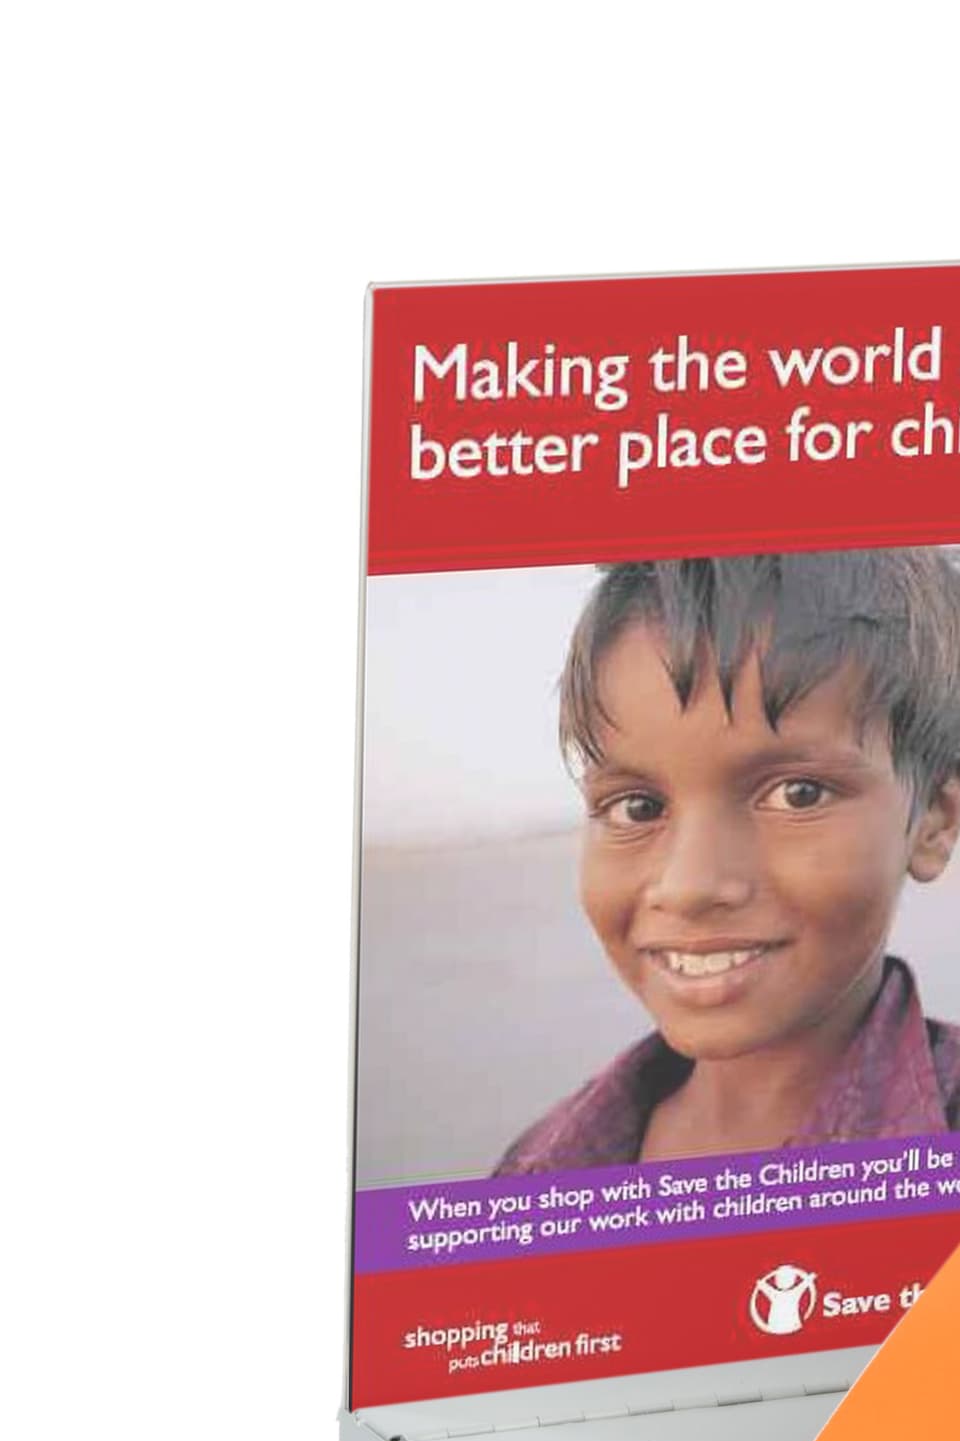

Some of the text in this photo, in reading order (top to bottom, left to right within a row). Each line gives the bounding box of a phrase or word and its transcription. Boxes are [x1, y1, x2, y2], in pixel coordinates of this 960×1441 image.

[413, 342, 629, 411] Making
[649, 335, 746, 392] the
[767, 325, 942, 387] world
[410, 424, 599, 480] better
[618, 414, 767, 487] place
[786, 406, 873, 462] for
[408, 1198, 481, 1221] When
[489, 1197, 531, 1219] you
[539, 1187, 594, 1211] shop
[602, 1177, 651, 1202] with
[659, 1174, 708, 1197] Save
[716, 1169, 752, 1191] the
[759, 1160, 855, 1186] Children
[927, 1149, 953, 1168] be
[408, 1221, 533, 1253] supporting
[540, 1217, 582, 1237] our
[590, 1206, 649, 1231] work
[657, 1200, 705, 1224] with
[713, 1194, 802, 1219] children
[809, 1181, 887, 1209] around
[895, 1176, 929, 1200] the
[404, 1320, 540, 1350] shopping that
[822, 1282, 925, 1318] Save th
[481, 1338, 571, 1366] children
[575, 1333, 622, 1357] first
